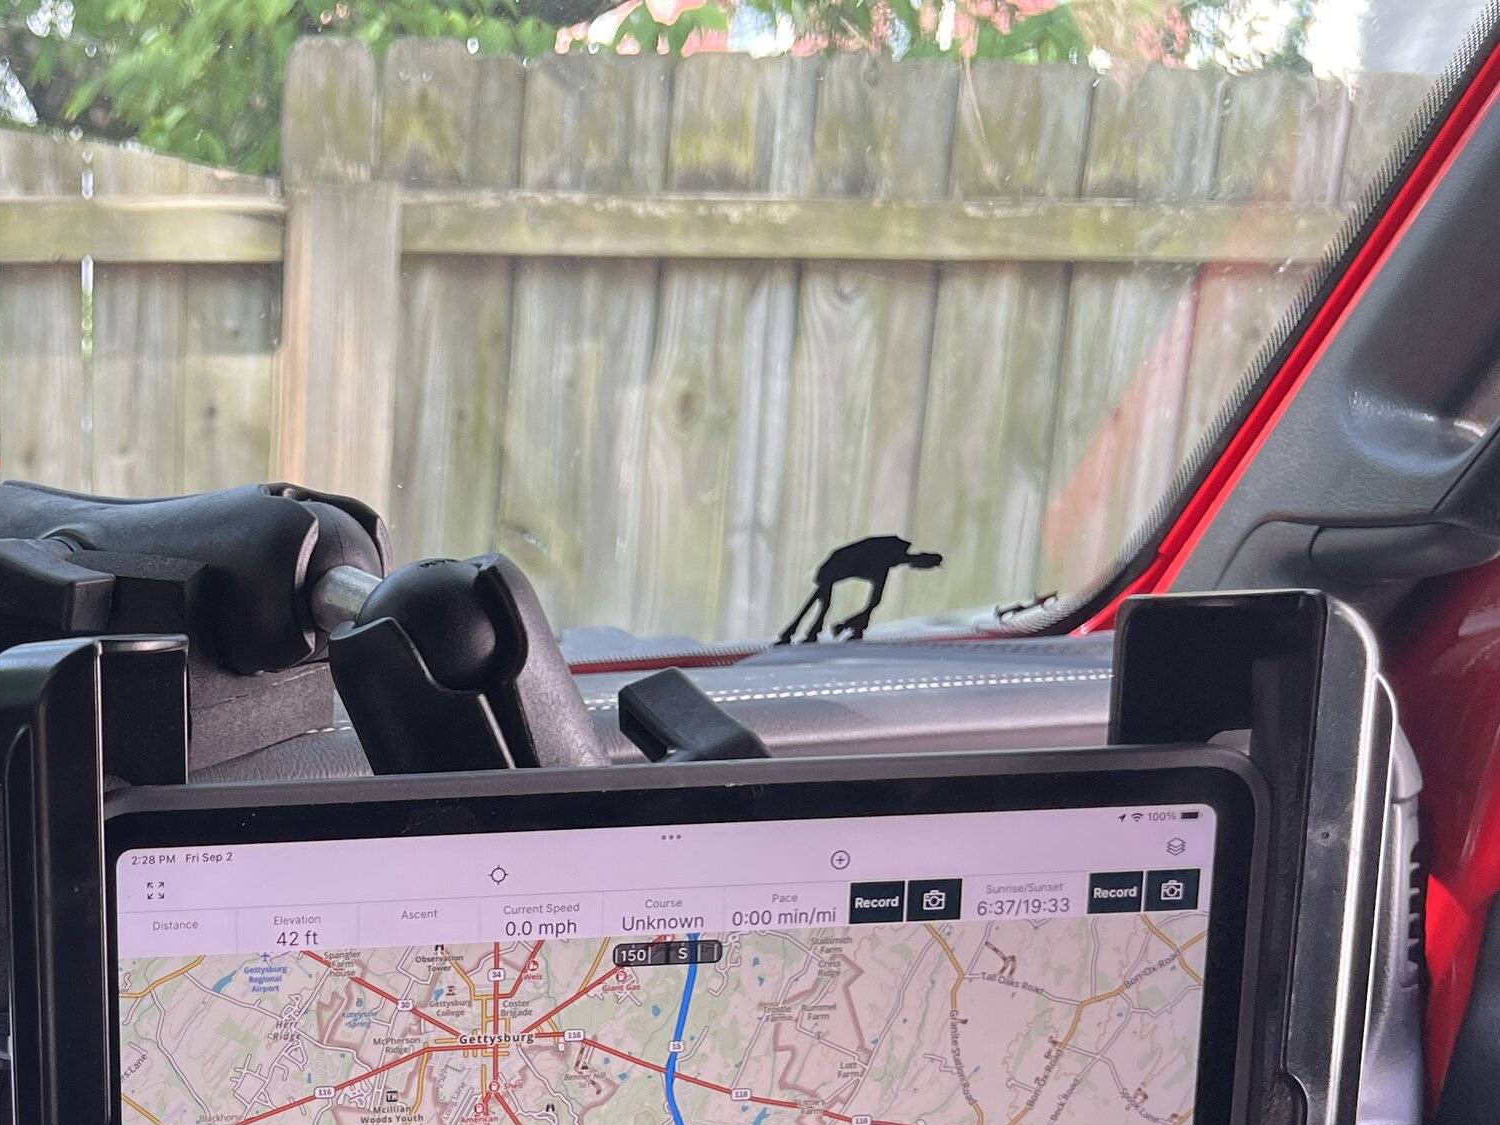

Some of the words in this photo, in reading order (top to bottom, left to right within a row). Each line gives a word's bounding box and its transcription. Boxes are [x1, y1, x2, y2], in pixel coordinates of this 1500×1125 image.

[1148, 812, 1176, 821] 100%
[132, 855, 156, 865] 2:28
[159, 854, 175, 864] PM
[186, 853, 199, 863] Fri
[203, 853, 222, 865] Sep
[227, 853, 233, 861] 2
[986, 882, 1063, 894] Sunrise/Sunset
[1093, 886, 1137, 898] Record
[772, 894, 798, 903] Pace
[855, 897, 899, 908] Record
[503, 905, 543, 915] Current
[547, 903, 580, 915] Speed
[645, 899, 682, 909] Course
[977, 898, 1070, 916] 6:37/19:33
[274, 914, 321, 925] Elevation
[401, 910, 437, 919] Ascent
[732, 910, 772, 926] 0:00
[778, 908, 836, 925] min/mi
[152, 920, 198, 931] Distance
[622, 915, 704, 931] Unknown
[505, 920, 532, 936] 0.0
[539, 919, 577, 941] mph
[276, 932, 299, 946] 42
[305, 930, 318, 945] ft
[679, 948, 687, 959] S
[820, 945, 842, 953] Farm
[324, 951, 361, 960] Spangler
[416, 954, 463, 963] Observation
[621, 949, 646, 961] 150
[244, 966, 287, 975] Gettysburg
[329, 969, 355, 977] house
[249, 975, 282, 984] Regional
[252, 985, 279, 993] Airport
[603, 983, 624, 992] Giant
[624, 983, 640, 991] Gas
[429, 1000, 472, 1009] Gettysburg
[503, 1000, 529, 1008] Coster
[436, 1009, 465, 1017] College
[501, 1009, 532, 1018] Brigade
[276, 1020, 299, 1029] Herr
[273, 1032, 302, 1042] Ridge
[373, 1036, 421, 1045] McPherson
[459, 1033, 534, 1045] Gettysburg
[361, 1115, 389, 1124] Woods
[392, 1114, 424, 1123] Youth
